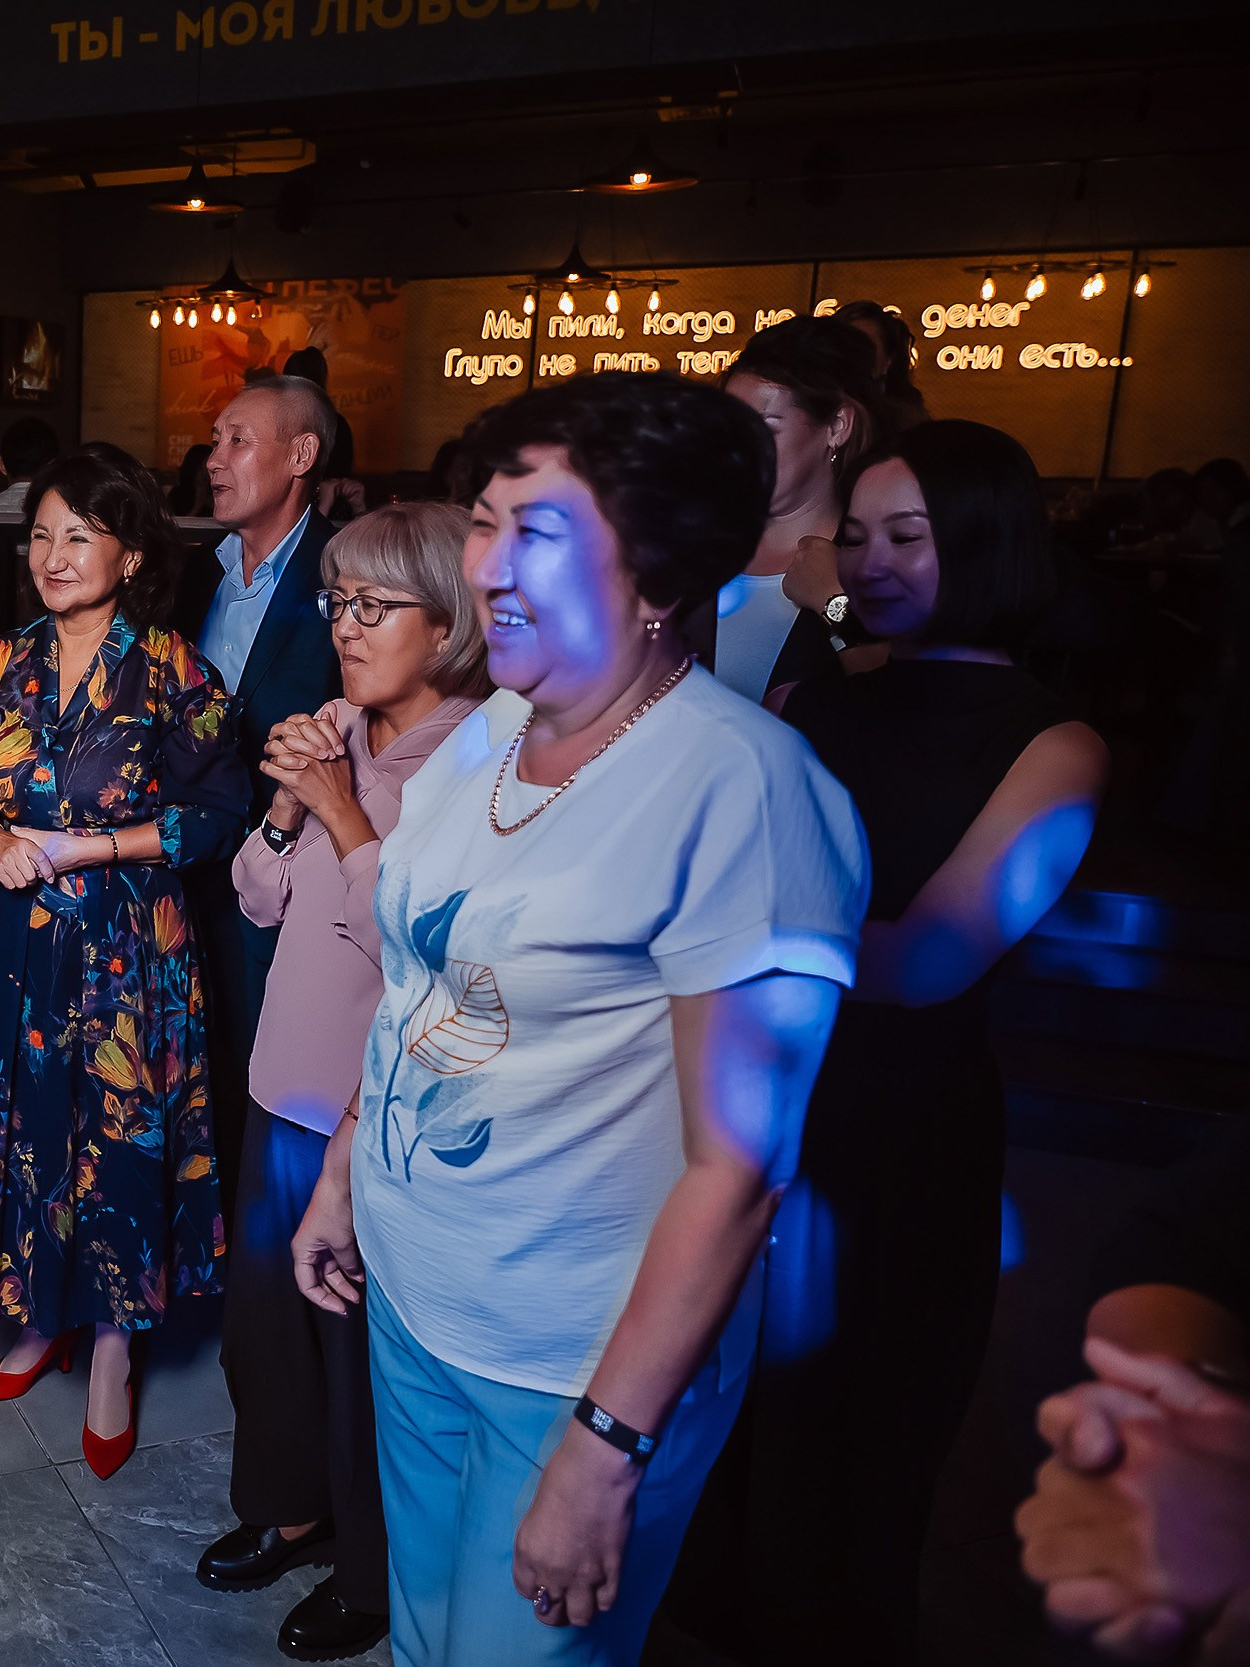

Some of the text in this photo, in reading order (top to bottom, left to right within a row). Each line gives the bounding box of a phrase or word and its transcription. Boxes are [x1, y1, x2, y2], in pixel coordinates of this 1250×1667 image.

[50, 16, 123, 63] ТЫ
[175, 0, 294, 52] МОЯ
[481, 309, 532, 340] Мы
[548, 313, 626, 340] пили,
[642, 310, 736, 343] когда
[921, 301, 1031, 338] денег
[168, 345, 204, 366] ЕШЬ
[444, 347, 524, 386] Глупо
[539, 353, 577, 377] не
[593, 352, 661, 374] пить
[936, 344, 1004, 370] они
[1019, 342, 1134, 369] есть...
